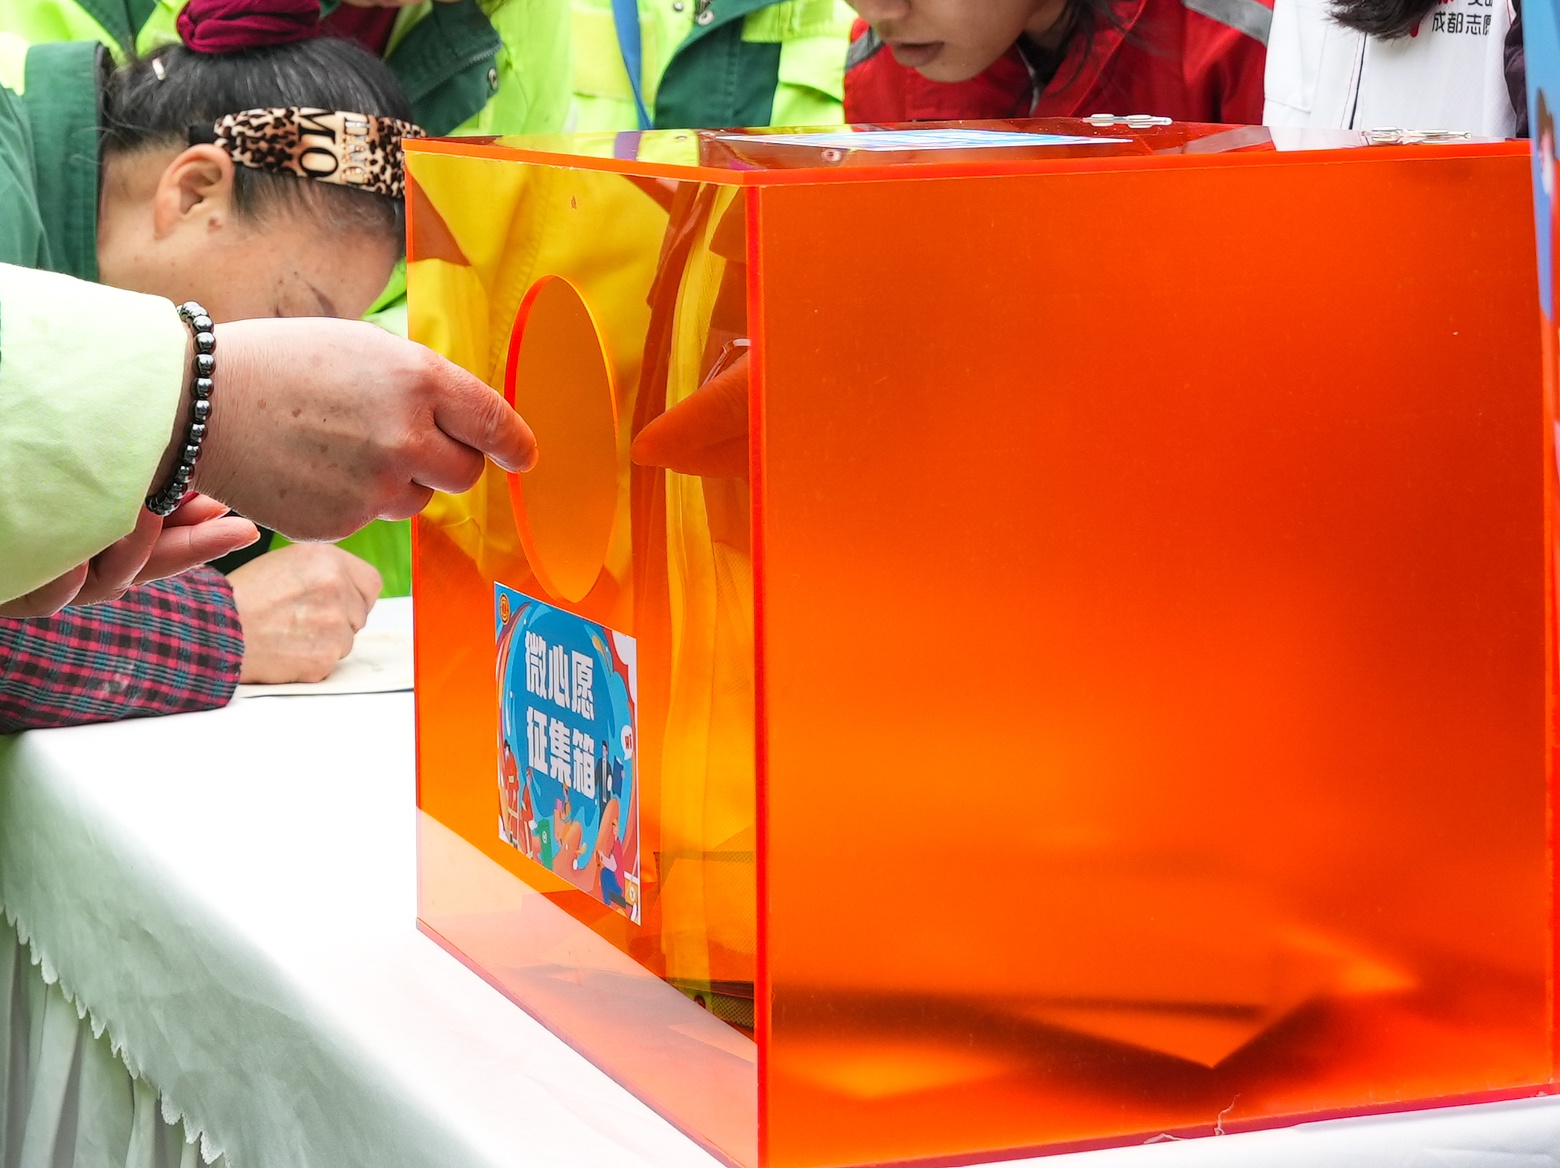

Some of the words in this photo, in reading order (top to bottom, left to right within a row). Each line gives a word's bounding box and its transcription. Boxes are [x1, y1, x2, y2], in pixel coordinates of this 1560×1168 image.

[524, 629, 595, 722] 微心愿
[525, 705, 596, 800] 征集箱
